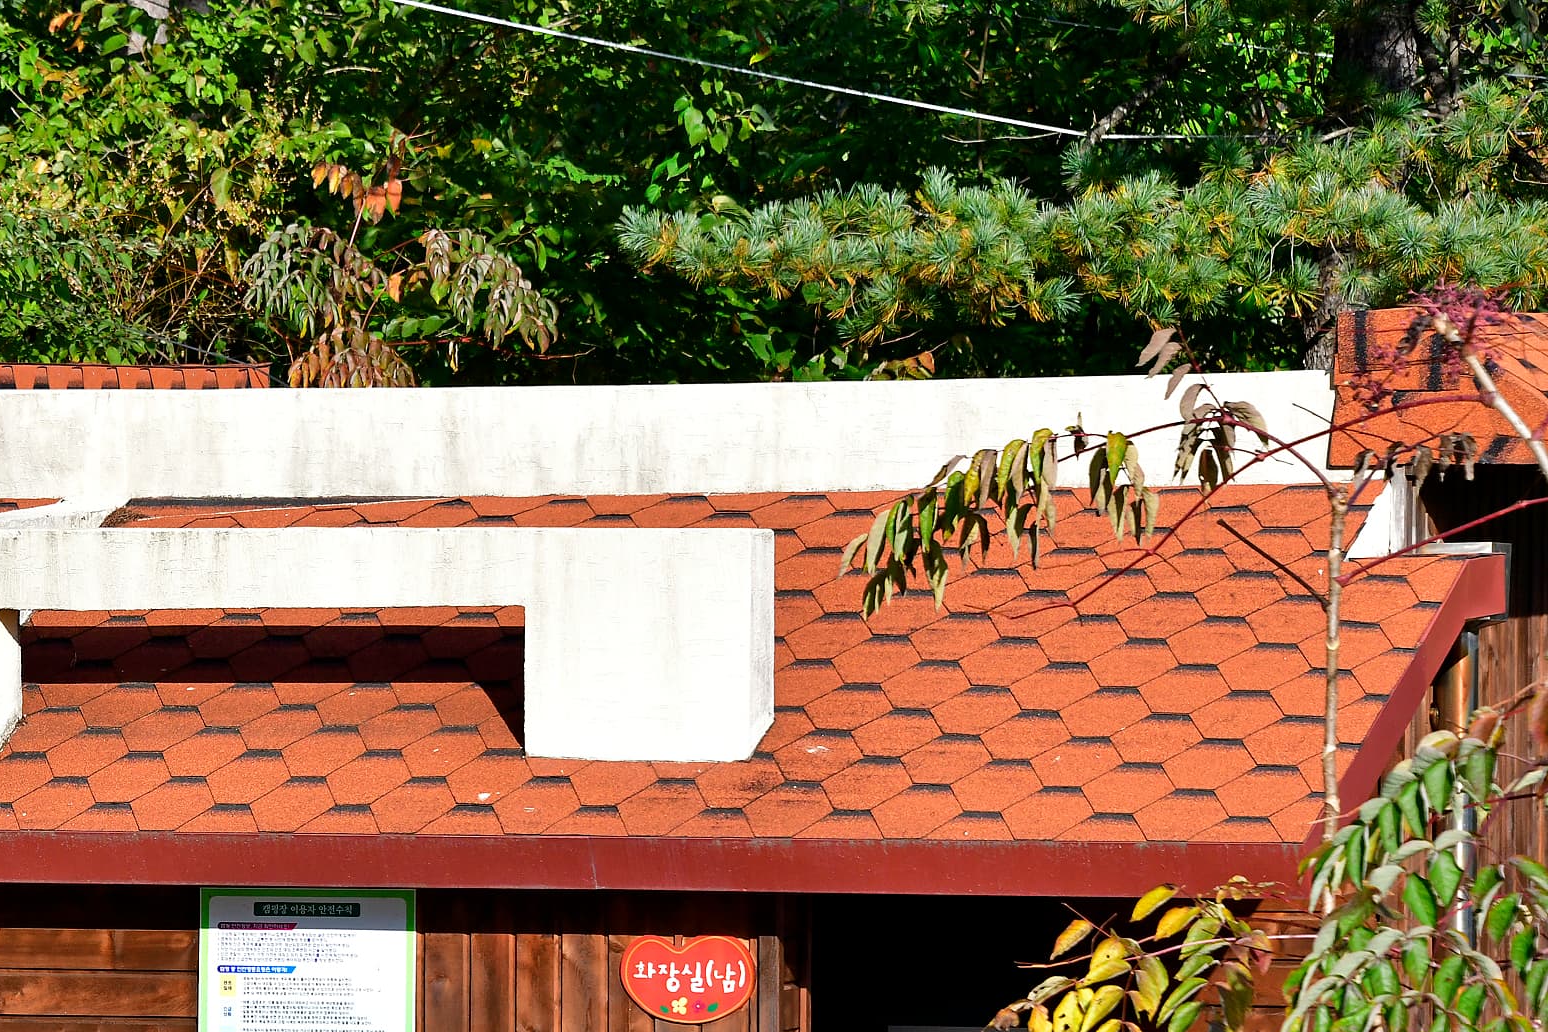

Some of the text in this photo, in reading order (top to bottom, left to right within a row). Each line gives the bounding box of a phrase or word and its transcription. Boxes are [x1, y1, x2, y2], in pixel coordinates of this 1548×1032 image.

[262, 904, 353, 916] 캠핑장 이용자 안전수칙
[633, 959, 746, 993] 화장실(남)
